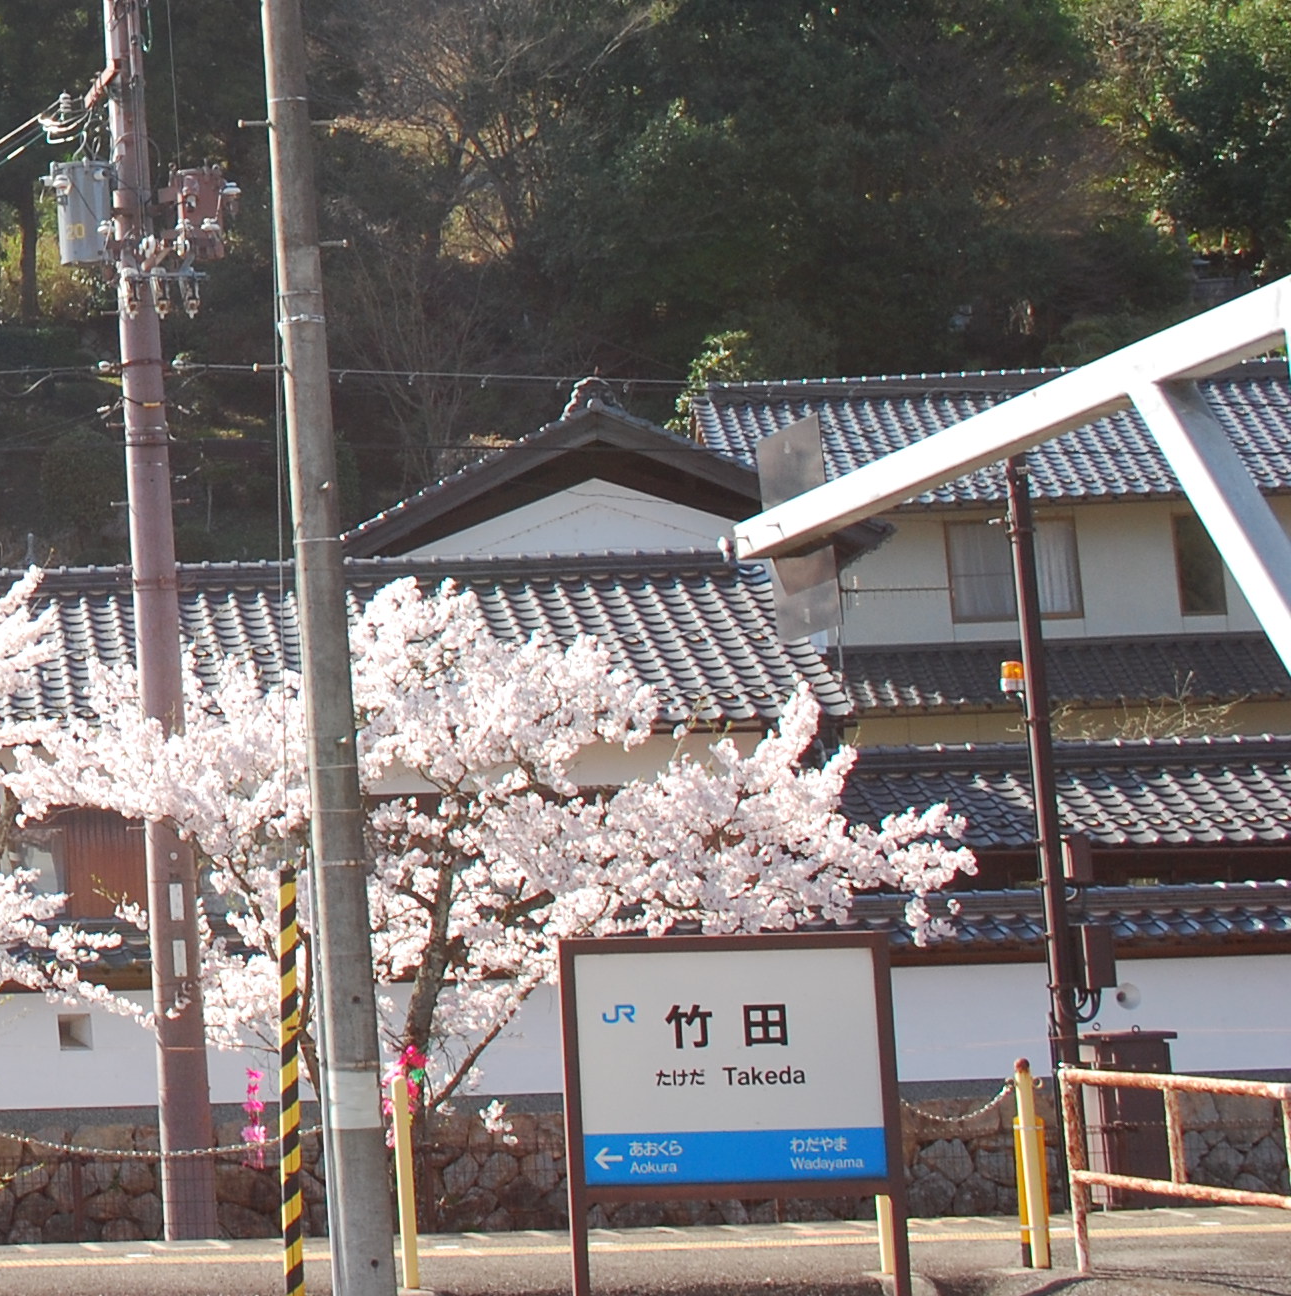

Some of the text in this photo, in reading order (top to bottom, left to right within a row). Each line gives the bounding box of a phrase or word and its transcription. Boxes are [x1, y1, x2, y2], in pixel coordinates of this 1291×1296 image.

[602, 1004, 635, 1023] JR
[665, 1003, 789, 1049] 竹田
[655, 1065, 806, 1086] たけだ Takeda
[628, 1140, 683, 1157] あおくら
[789, 1136, 848, 1153] わだやま
[629, 1161, 678, 1174] Aokura
[790, 1156, 865, 1172] Wadayama
